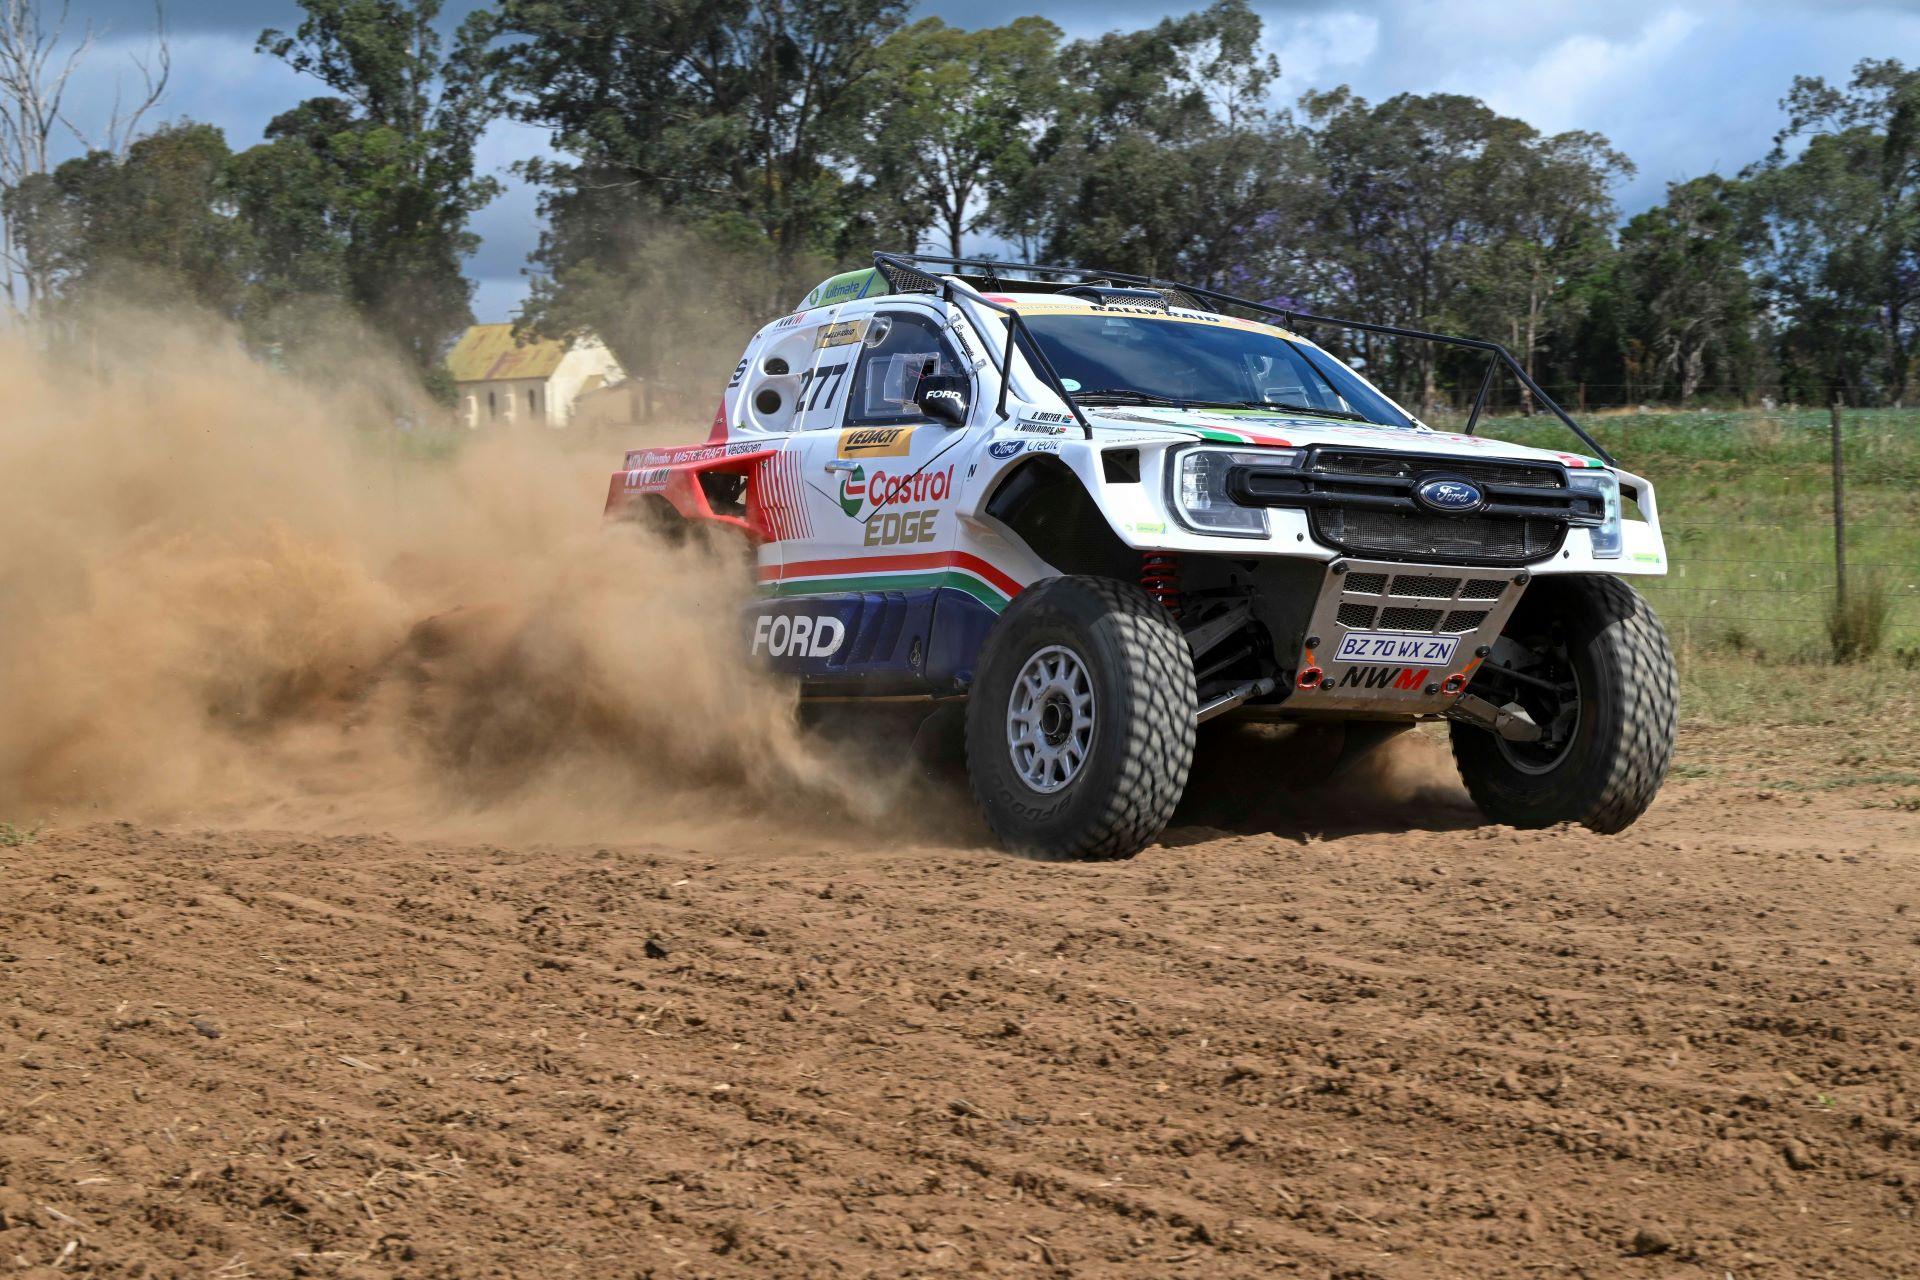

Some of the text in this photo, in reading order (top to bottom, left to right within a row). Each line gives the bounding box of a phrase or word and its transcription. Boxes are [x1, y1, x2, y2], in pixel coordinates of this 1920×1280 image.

[795, 362, 849, 414] 277
[925, 390, 962, 400] FORD
[1039, 412, 1062, 423] DREYER
[846, 429, 905, 445] VEDACIT
[672, 447, 726, 464] MASTERCRAFT
[868, 463, 955, 507] Castrol
[1436, 485, 1470, 503] Ford
[864, 509, 940, 547] EDGE
[751, 614, 846, 658] FORD
[1342, 639, 1452, 660] BZ 70 WX ZN
[1338, 666, 1431, 691] NWM
